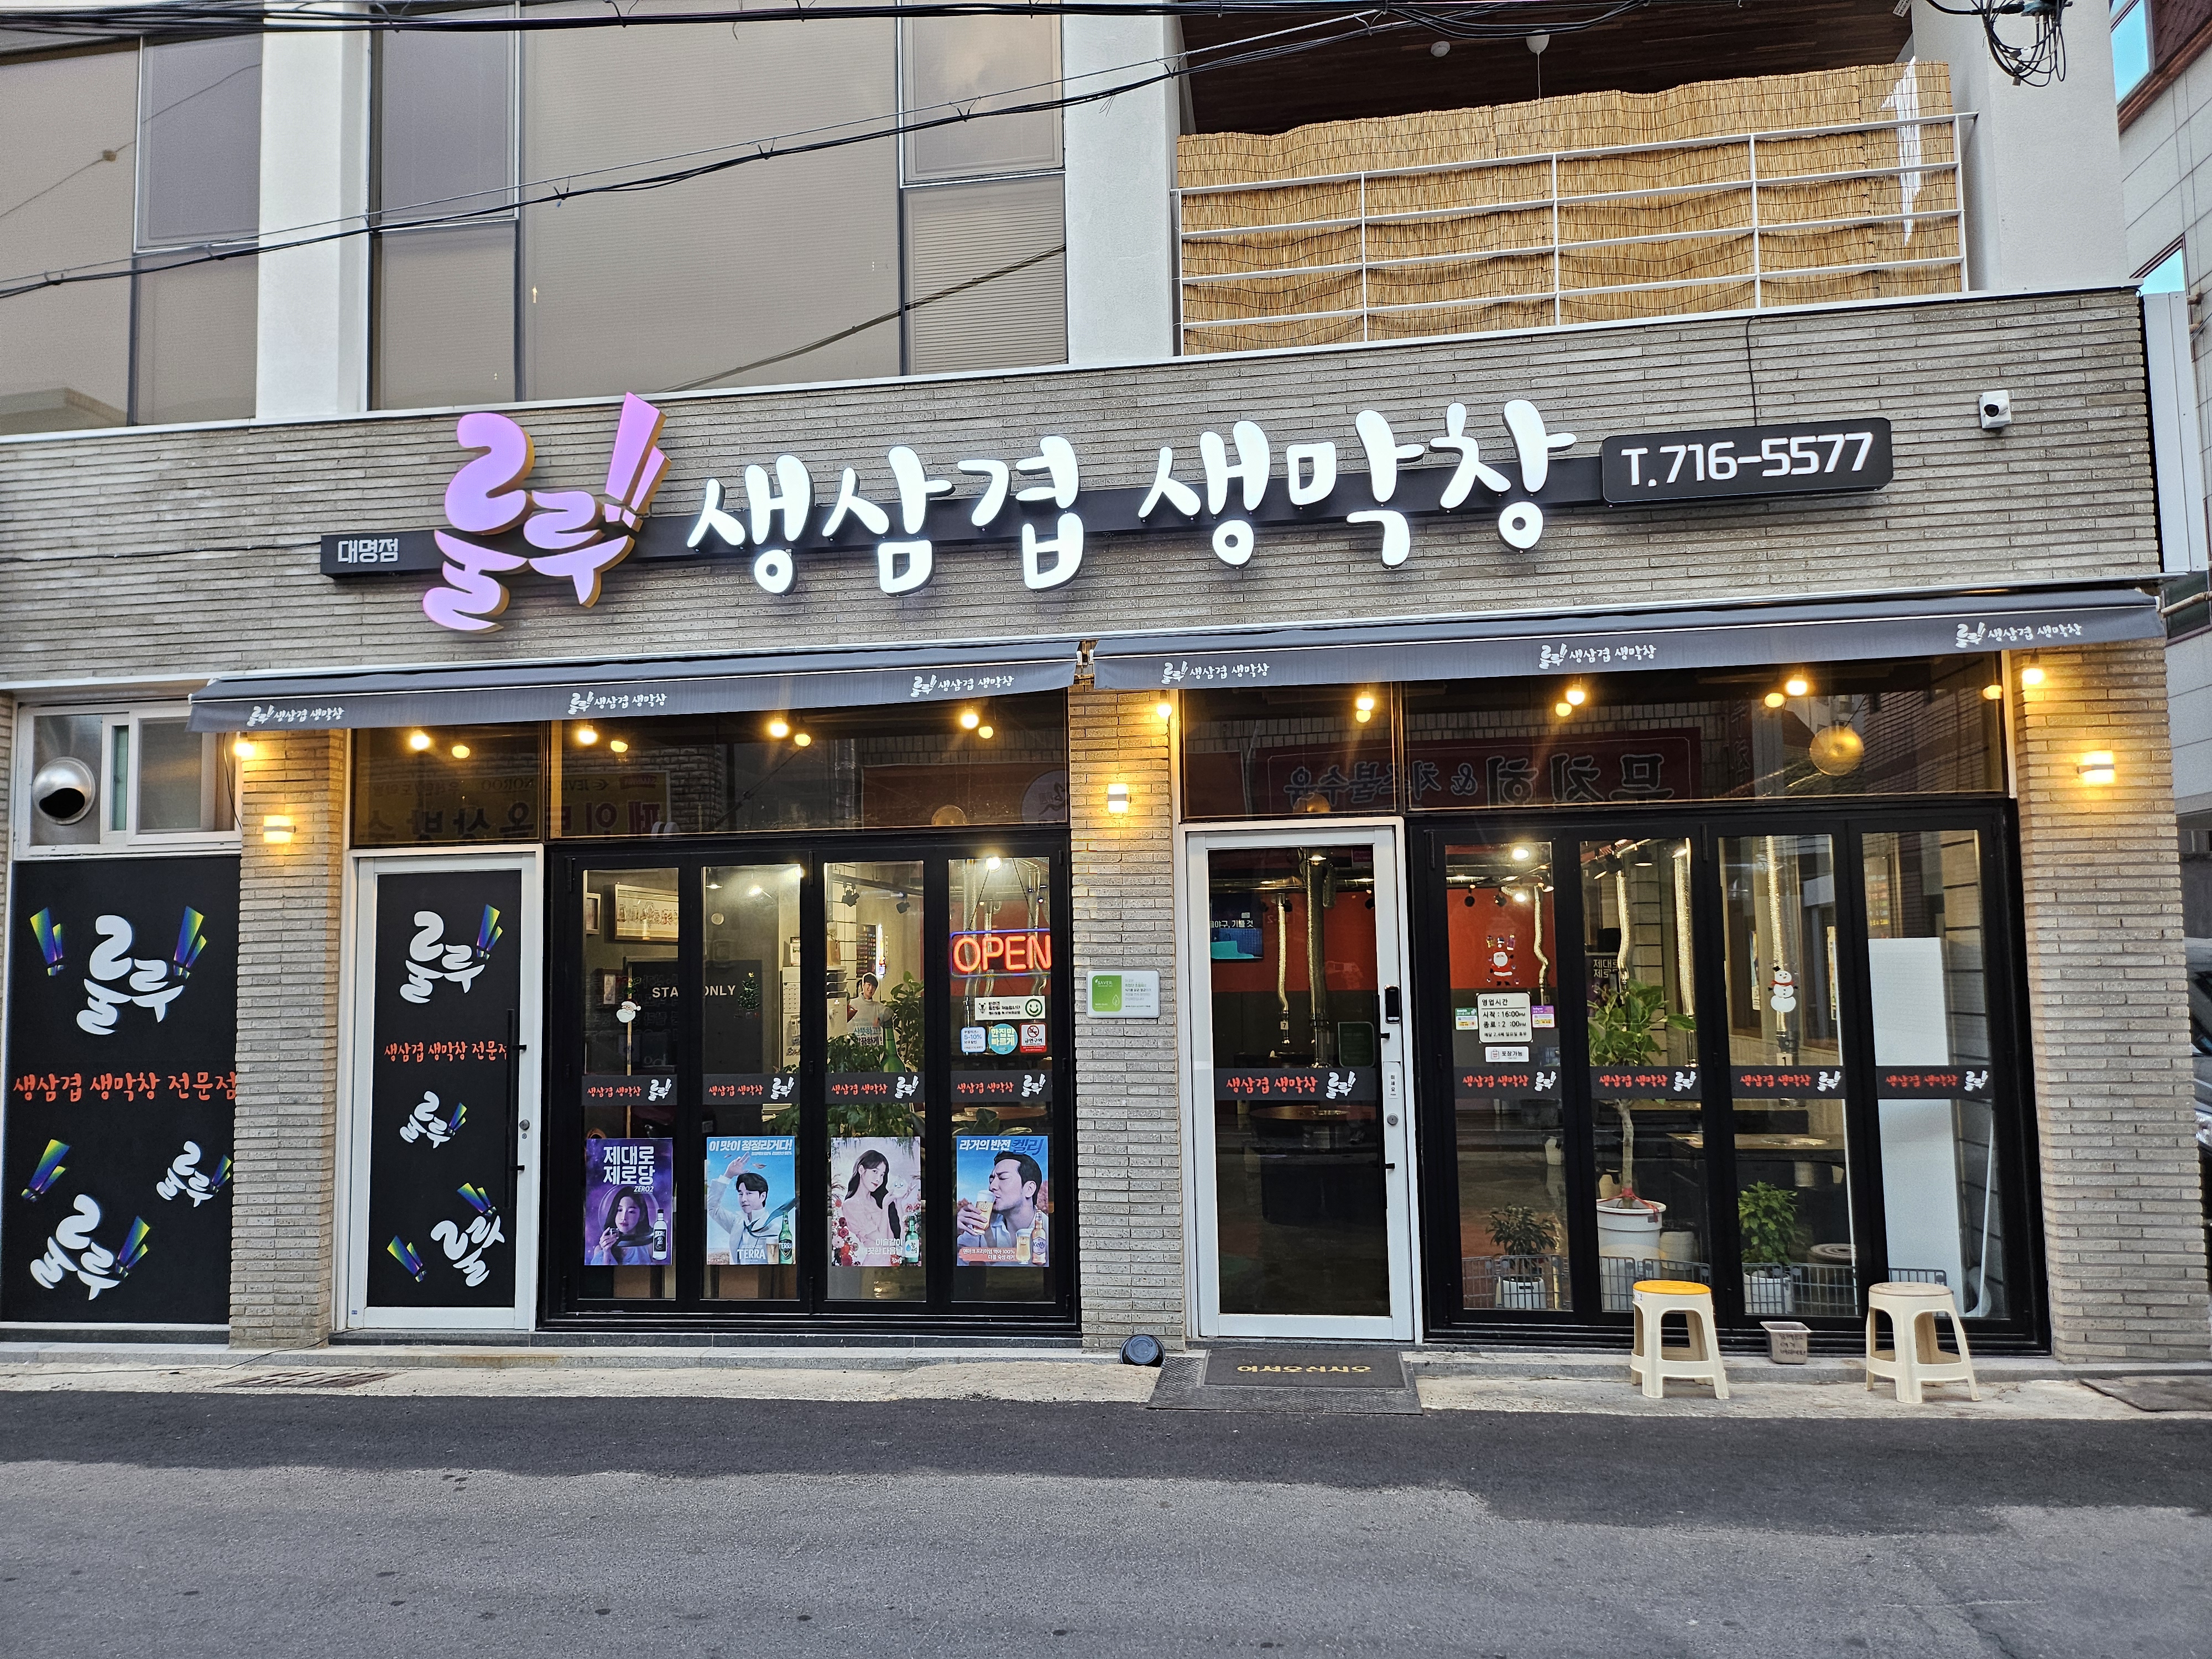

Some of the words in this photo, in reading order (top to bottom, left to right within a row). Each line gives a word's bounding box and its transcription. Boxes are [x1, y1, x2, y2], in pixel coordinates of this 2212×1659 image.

[1621, 431, 1874, 487] T.716-5577
[687, 435, 1084, 597] 생삼겹
[1138, 399, 1578, 569] 생막창
[337, 538, 399, 563] 대명점
[1987, 625, 2034, 641] 생삼겹
[2037, 623, 2083, 638] 생막창
[1569, 647, 1611, 663] 생삼겹
[1614, 644, 1657, 660] 생막창
[1190, 666, 1228, 680] 생삼겹
[1231, 662, 1270, 677] 생막창
[938, 678, 974, 691] 생삼겹
[978, 675, 1015, 688] 생막창
[594, 695, 629, 709] 생삼겹
[632, 692, 667, 707] 생막창
[274, 708, 307, 723] 생삼겹
[310, 706, 345, 721] 생막창
[953, 935, 1052, 973] OPEN
[652, 987, 679, 998] STA
[991, 1028, 1016, 1037] 한집만
[384, 1041, 424, 1063] 생삼겹
[428, 1041, 468, 1061] 생막창
[14, 1073, 82, 1102] 생삼겹
[90, 1073, 159, 1101] 생막창
[169, 1072, 236, 1101] 전문점
[832, 1084, 859, 1096] 생삼겹
[861, 1083, 888, 1095] 생막창
[957, 1082, 985, 1094] 생삼겹
[987, 1082, 1015, 1093] 생막창
[1226, 1076, 1270, 1094] 생삼겹
[1274, 1076, 1318, 1094] 생막창
[1462, 1075, 1495, 1088] 생삼겹
[1497, 1074, 1529, 1087] 생막창
[1599, 1074, 1632, 1088] 생삼겹
[1635, 1074, 1668, 1087] 생막창
[1740, 1074, 1775, 1088] 생삼겹
[1777, 1074, 1812, 1087] 생막창
[1885, 1074, 1921, 1088] 생삼겹
[1923, 1074, 1959, 1087] 생막창
[587, 1086, 613, 1098] 생삼겹
[616, 1085, 642, 1097] 생막창
[708, 1085, 735, 1097] 생삼겹
[737, 1084, 764, 1096] 생막창
[709, 1140, 719, 1151] 이
[720, 1140, 741, 1151] 맛이
[741, 1139, 793, 1151] 청정라거다!
[959, 1140, 990, 1151] 라거의
[990, 1139, 1011, 1151] 반전
[1011, 1139, 1044, 1156] 켈리
[603, 1146, 655, 1165] 제대로
[603, 1165, 656, 1186] 제로당
[737, 1249, 766, 1259] TERRA
